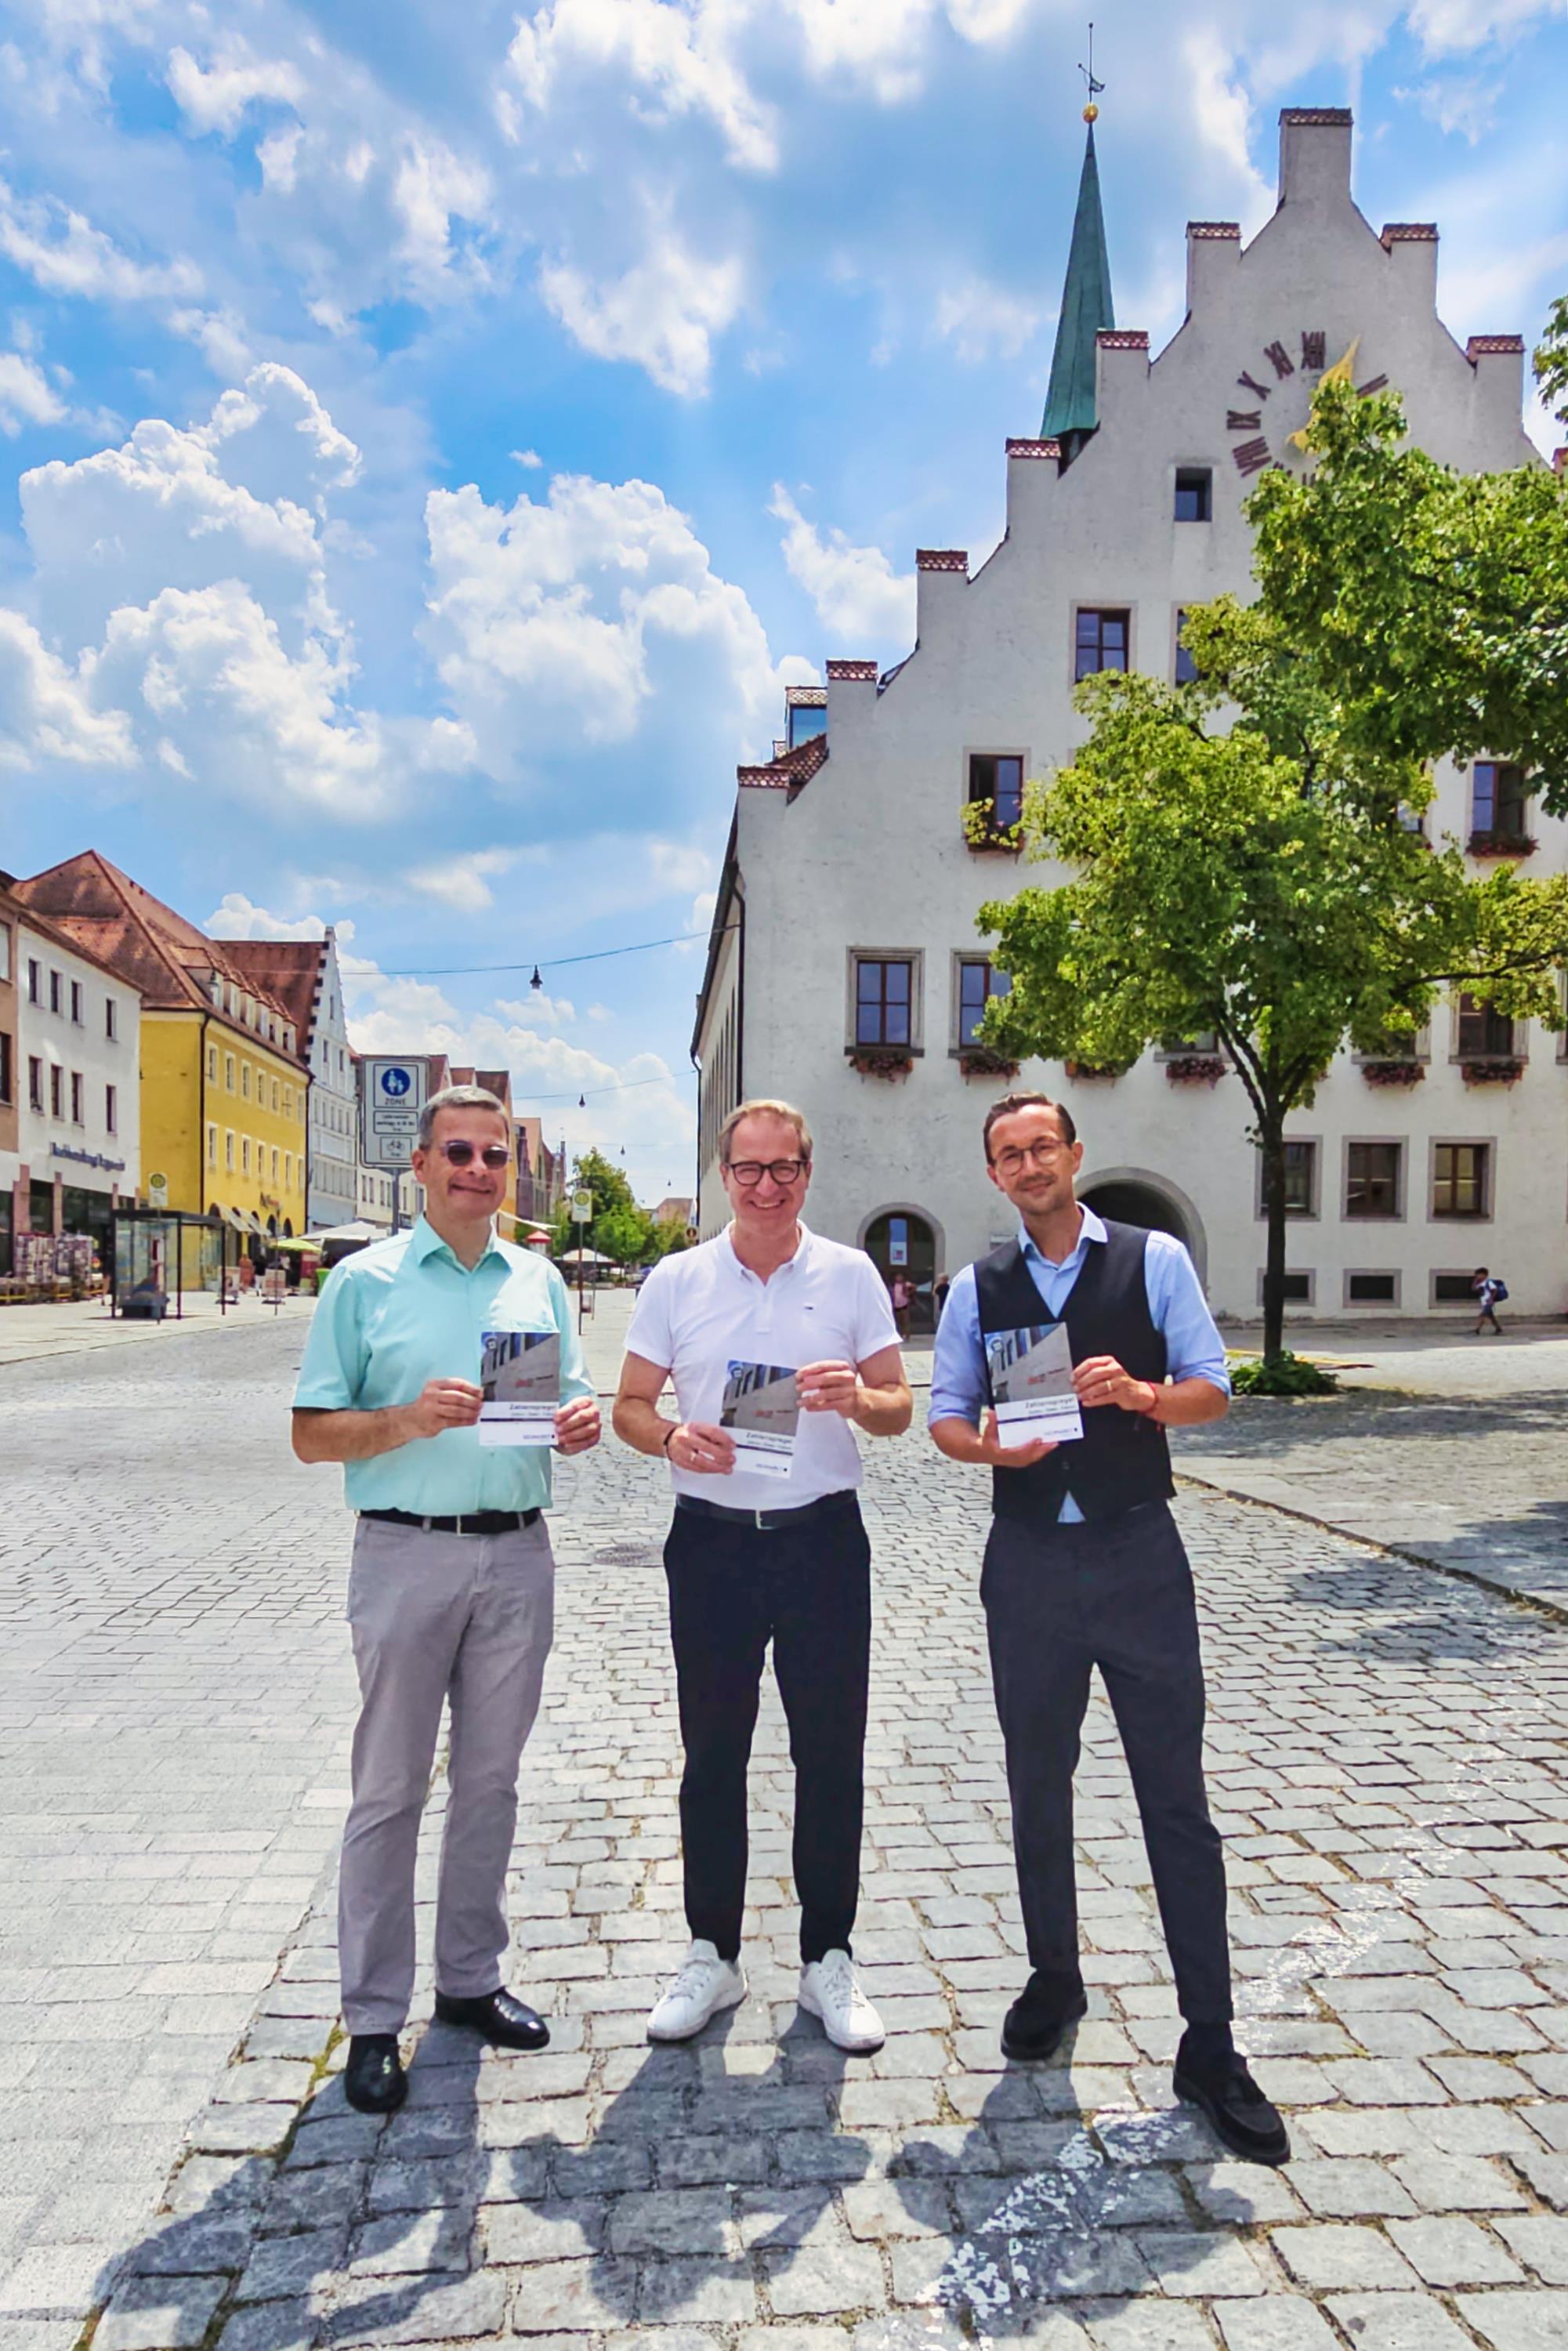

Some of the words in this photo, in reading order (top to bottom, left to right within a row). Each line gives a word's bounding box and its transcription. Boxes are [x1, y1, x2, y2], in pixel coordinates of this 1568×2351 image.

[1262, 340, 1295, 380] XI
[1301, 331, 1326, 369] XII
[1237, 370, 1272, 401] X
[1226, 409, 1262, 430] IX
